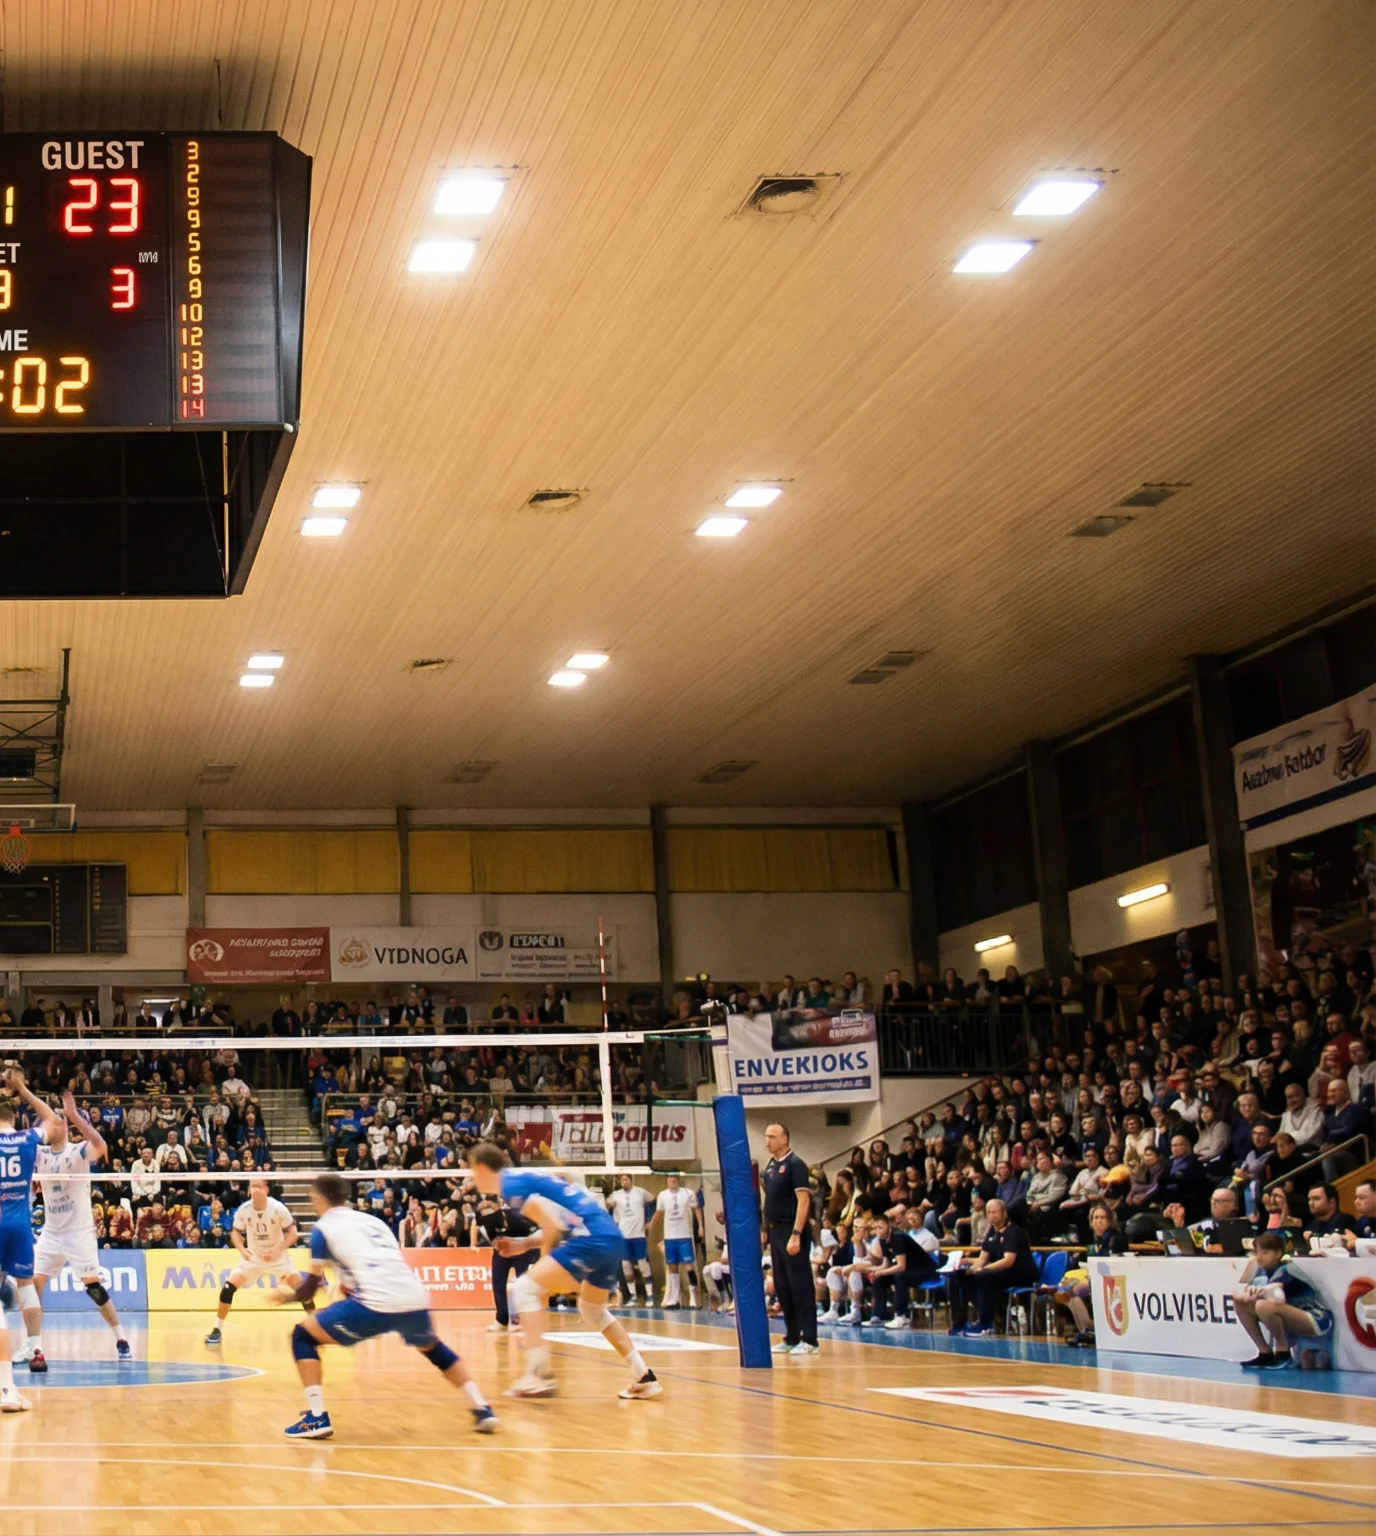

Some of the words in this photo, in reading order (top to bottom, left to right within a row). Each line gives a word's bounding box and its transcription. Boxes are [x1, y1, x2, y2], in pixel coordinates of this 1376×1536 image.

[41, 141, 145, 170] GUEST
[187, 141, 199, 160] 3
[186, 164, 200, 183] 2
[5, 186, 14, 225] 1
[64, 178, 139, 233] 23
[187, 209, 201, 228] 9
[188, 232, 201, 252] 5
[188, 255, 202, 275] 6
[111, 268, 135, 309] 3
[181, 303, 203, 322] 10
[181, 326, 204, 346] 12
[181, 350, 204, 370] 13
[181, 374, 204, 395] 13
[181, 398, 204, 419] 14
[734, 1050, 870, 1078] ENVEKIOKS
